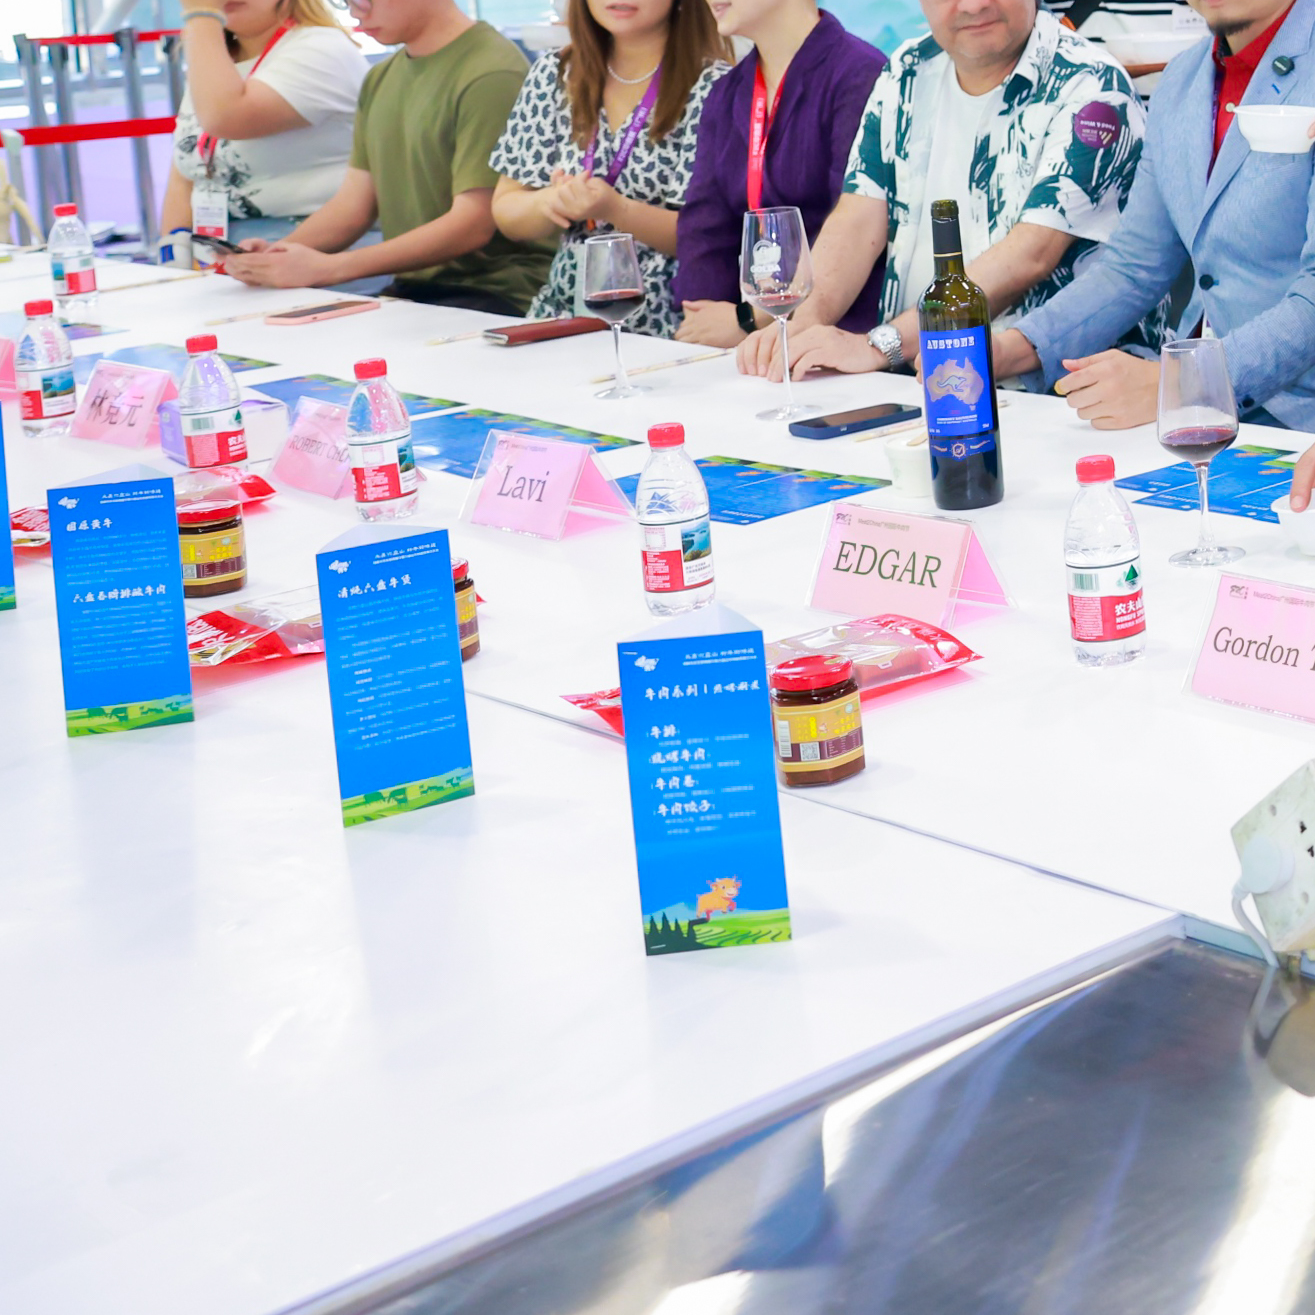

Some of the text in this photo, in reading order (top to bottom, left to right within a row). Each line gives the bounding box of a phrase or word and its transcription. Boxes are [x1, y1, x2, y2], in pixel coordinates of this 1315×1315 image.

[926, 336, 975, 350] AUSTONE
[497, 465, 550, 503] Lavi
[833, 540, 942, 588] EDGAR
[1213, 626, 1300, 667] Gordon
